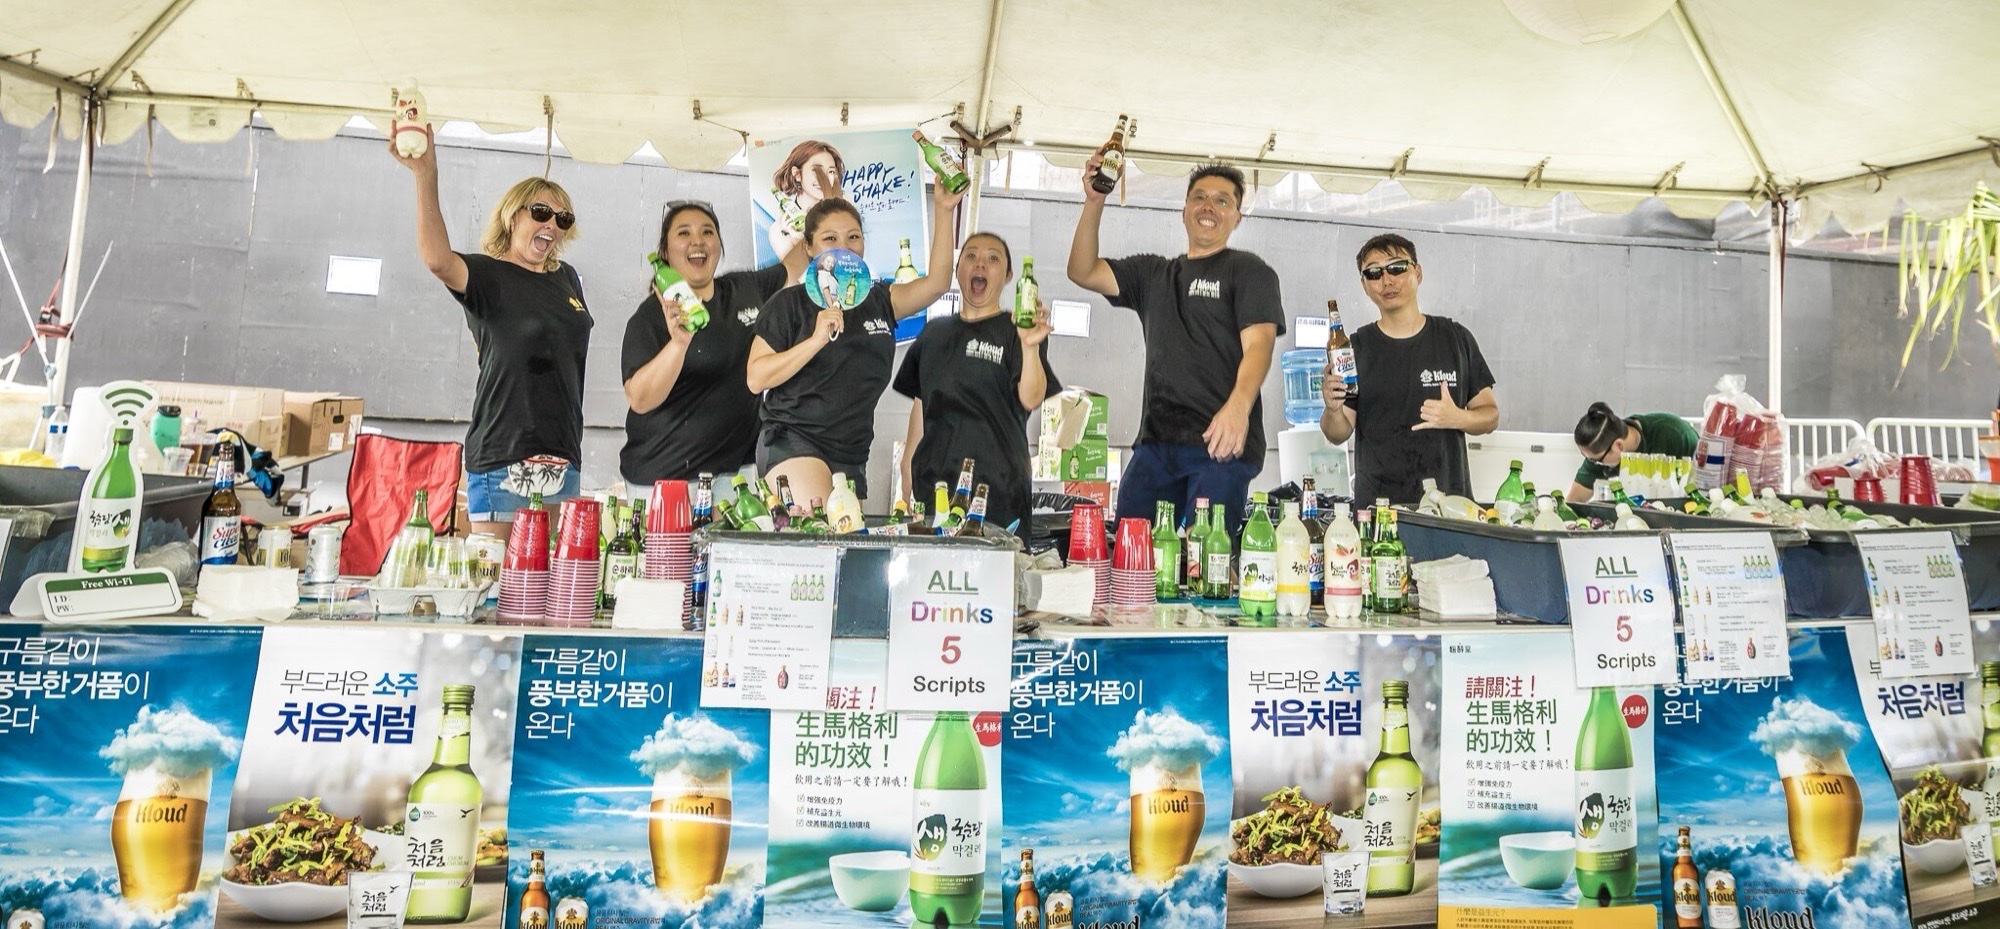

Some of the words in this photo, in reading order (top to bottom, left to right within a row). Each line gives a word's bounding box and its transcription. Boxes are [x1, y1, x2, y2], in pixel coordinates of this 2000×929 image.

[843, 162, 895, 187] HAPPY
[853, 171, 914, 203] SHAKE!
[1433, 369, 1457, 382] Kloud
[1595, 556, 1637, 576] ALL
[81, 580, 103, 589] Free
[105, 577, 133, 586] Wi-Fi
[927, 571, 979, 592] ALL
[1586, 584, 1654, 606] Drinks
[911, 602, 993, 624] Drinks
[1616, 616, 1634, 643] 5
[0, 636, 100, 665] 구름같이
[531, 648, 626, 675] 구름같이
[940, 635, 962, 664] 5
[1012, 649, 1097, 677] 구름같이
[1597, 652, 1656, 672] Scripts
[280, 669, 369, 696] 부드러운
[372, 672, 419, 697] 소주
[913, 675, 985, 697] Scripts
[1248, 670, 1320, 693] 부드러운
[1324, 671, 1362, 693] 소주
[1465, 675, 1537, 699] 請關注！
[1466, 699, 1557, 726] 生馬格利
[1662, 699, 1702, 725] 온다
[1878, 681, 1966, 720] 처음처럼
[274, 702, 416, 744] 처음처럼
[525, 711, 575, 740] 온다
[796, 711, 898, 739] 生馬格利
[1010, 711, 1056, 739] 온다
[1250, 699, 1362, 737] 처음처럼
[1466, 728, 1551, 754] 的功效！
[795, 741, 889, 769] 的功效！
[1800, 778, 1844, 795] Kloud
[135, 803, 188, 824] Kloud
[1148, 795, 1190, 815] Kloud
[1607, 794, 1631, 819] 국순당
[951, 818, 983, 842] 국순당
[1365, 820, 1392, 834] 처음
[408, 837, 443, 854] 처음
[1364, 835, 1394, 847] 처럼
[406, 854, 446, 868] 처럼
[1333, 868, 1353, 879] 처음
[1333, 879, 1353, 888] 처럼
[1708, 886, 1736, 903] Kloud
[1046, 908, 1072, 928] Kloud
[1744, 904, 1816, 929] Kloud
